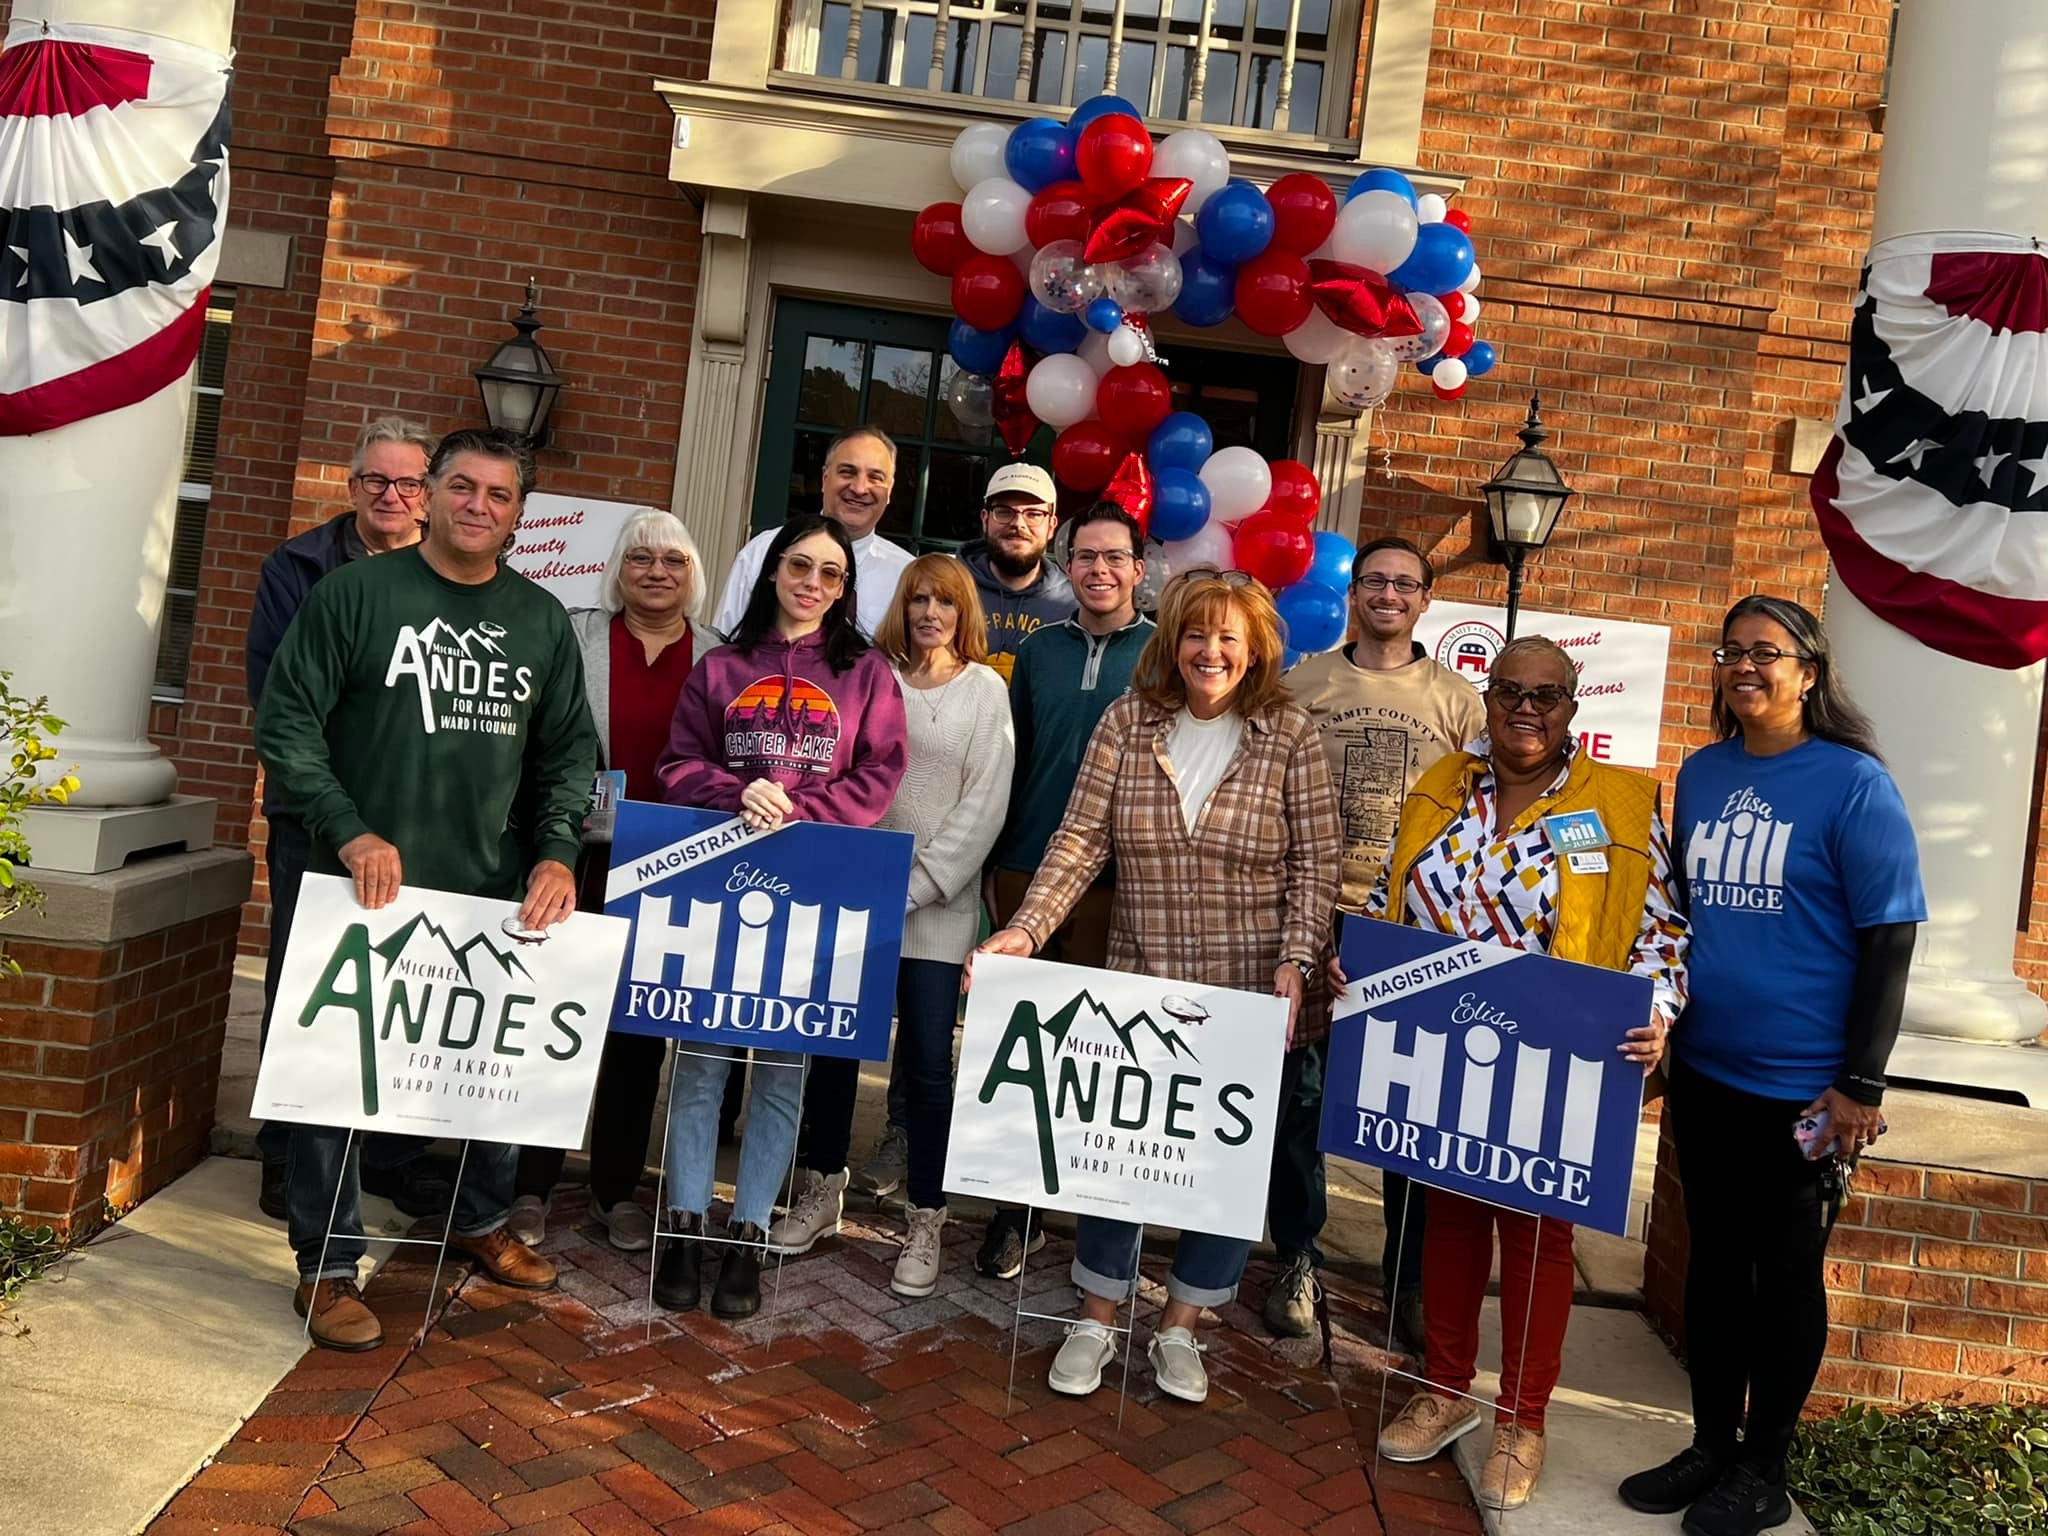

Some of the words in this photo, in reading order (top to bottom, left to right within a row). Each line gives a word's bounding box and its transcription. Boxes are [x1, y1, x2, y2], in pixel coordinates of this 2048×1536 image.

[507, 538, 567, 558] ounty
[521, 561, 605, 580] publicans
[1479, 627, 1505, 652] COUN
[385, 626, 532, 734] ANDES
[453, 698, 473, 713] FOR
[440, 715, 470, 731] WARD
[1378, 708, 1439, 743] COUNTY
[725, 732, 787, 756] CRATER
[792, 733, 836, 762] LAKE
[1721, 786, 1774, 819] Elisa
[636, 823, 755, 882] MAGISTRATE
[1686, 811, 1794, 887] Hill
[725, 862, 792, 896] Elisa
[1703, 883, 1784, 910] JUDGE
[631, 890, 870, 1005] Hill
[399, 958, 461, 982] MICHAEL
[1362, 948, 1482, 1003] MAGISTRATE
[298, 923, 587, 1116] ANDES
[625, 984, 693, 1024] FOR
[703, 992, 857, 1041] JUDGE
[1451, 992, 1520, 1034] Elisa
[1066, 1035, 1126, 1060] MICHAEL
[408, 1052, 442, 1071] FOR
[453, 1058, 513, 1078] AKRON
[393, 1076, 433, 1093] WARD
[458, 1084, 519, 1103] COUNCIL
[978, 1000, 1254, 1195] ANDES
[1356, 1013, 1604, 1167] Hill
[1084, 1131, 1115, 1151] FOR
[1127, 1139, 1186, 1162] AKRON
[1354, 1111, 1420, 1161] FOR
[1428, 1130, 1592, 1207] JUDGE
[1070, 1155, 1109, 1173] WARD
[1134, 1166, 1195, 1188] COUNCIL
